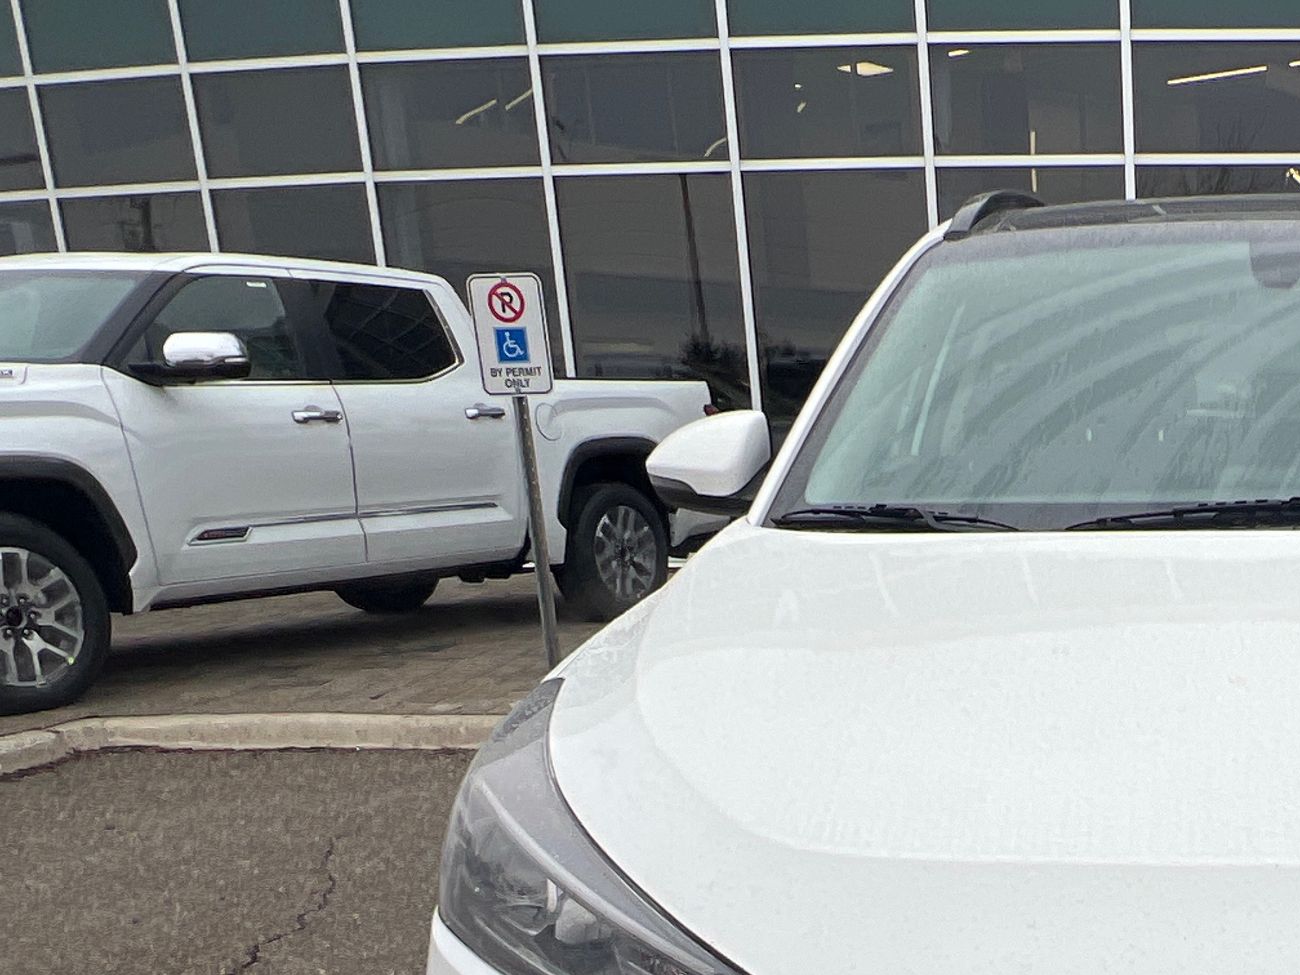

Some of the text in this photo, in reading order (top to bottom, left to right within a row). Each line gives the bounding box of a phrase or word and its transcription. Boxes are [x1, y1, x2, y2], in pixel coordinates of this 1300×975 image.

[490, 366, 541, 377] BY PERMIT
[505, 378, 530, 388] ONLY
